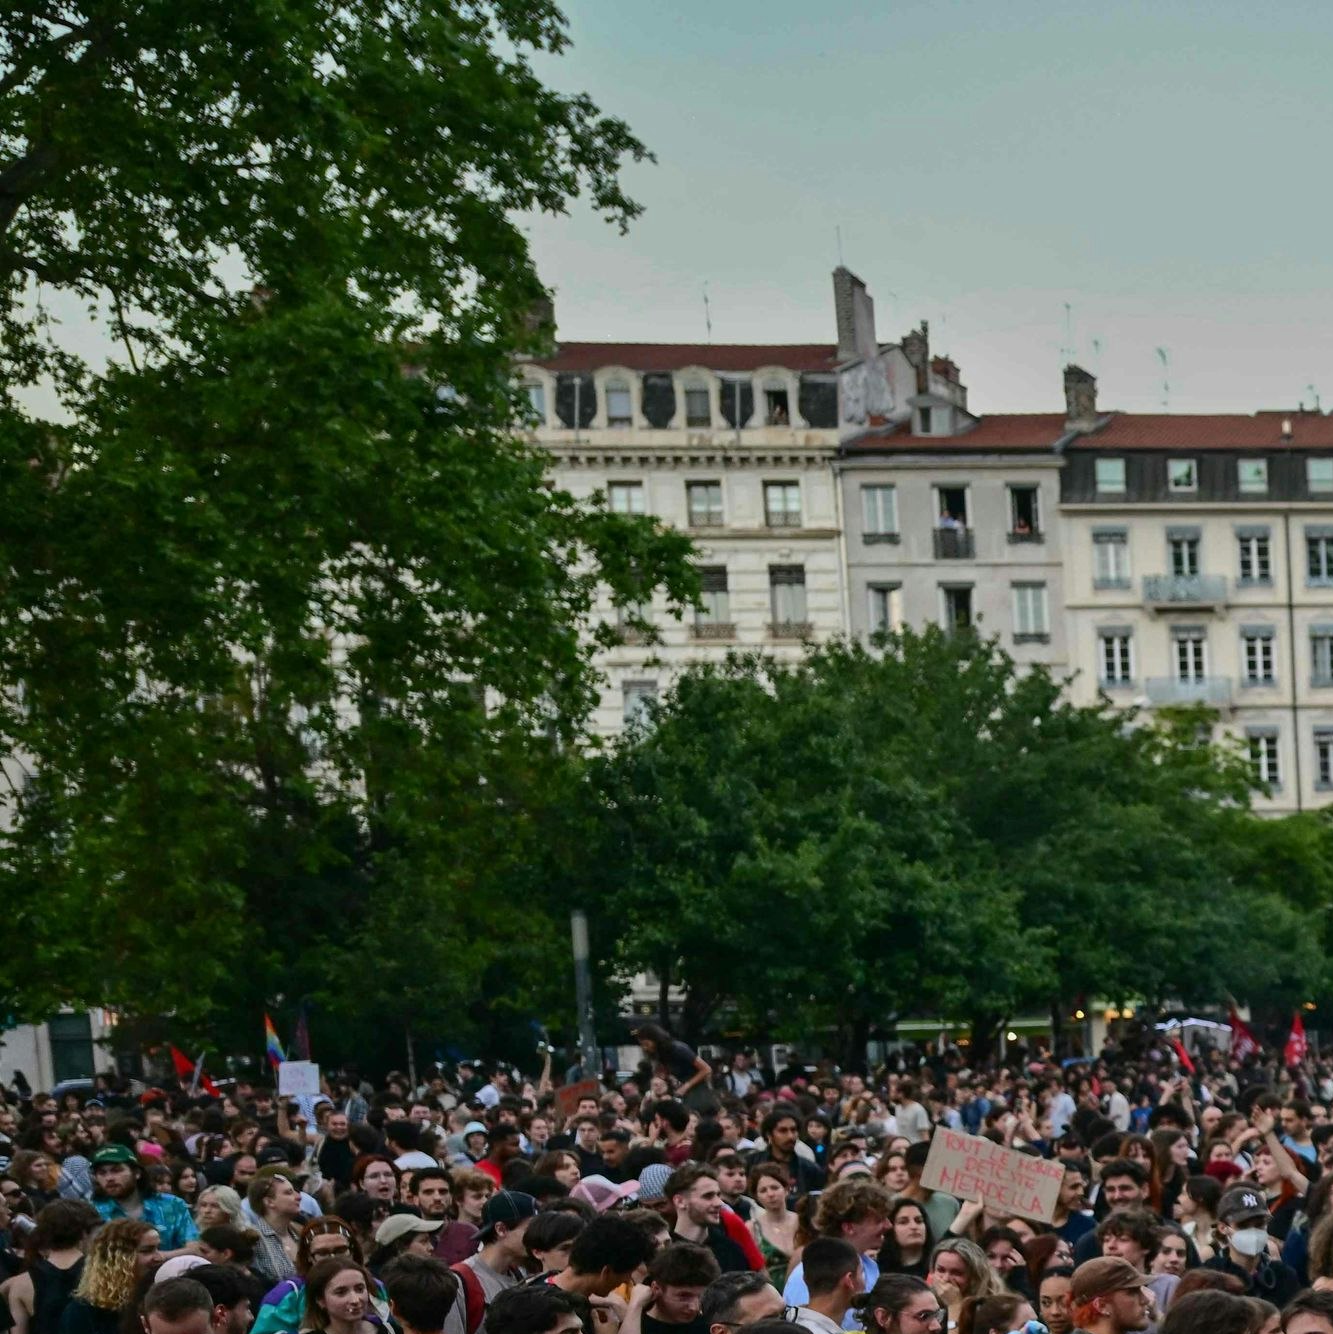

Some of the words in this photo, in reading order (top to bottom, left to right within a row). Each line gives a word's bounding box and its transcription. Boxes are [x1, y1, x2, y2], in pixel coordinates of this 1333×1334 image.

[943, 1131, 982, 1155] TOUT
[990, 1146, 1011, 1169] LE
[940, 1166, 1043, 1215] MERDELLA
